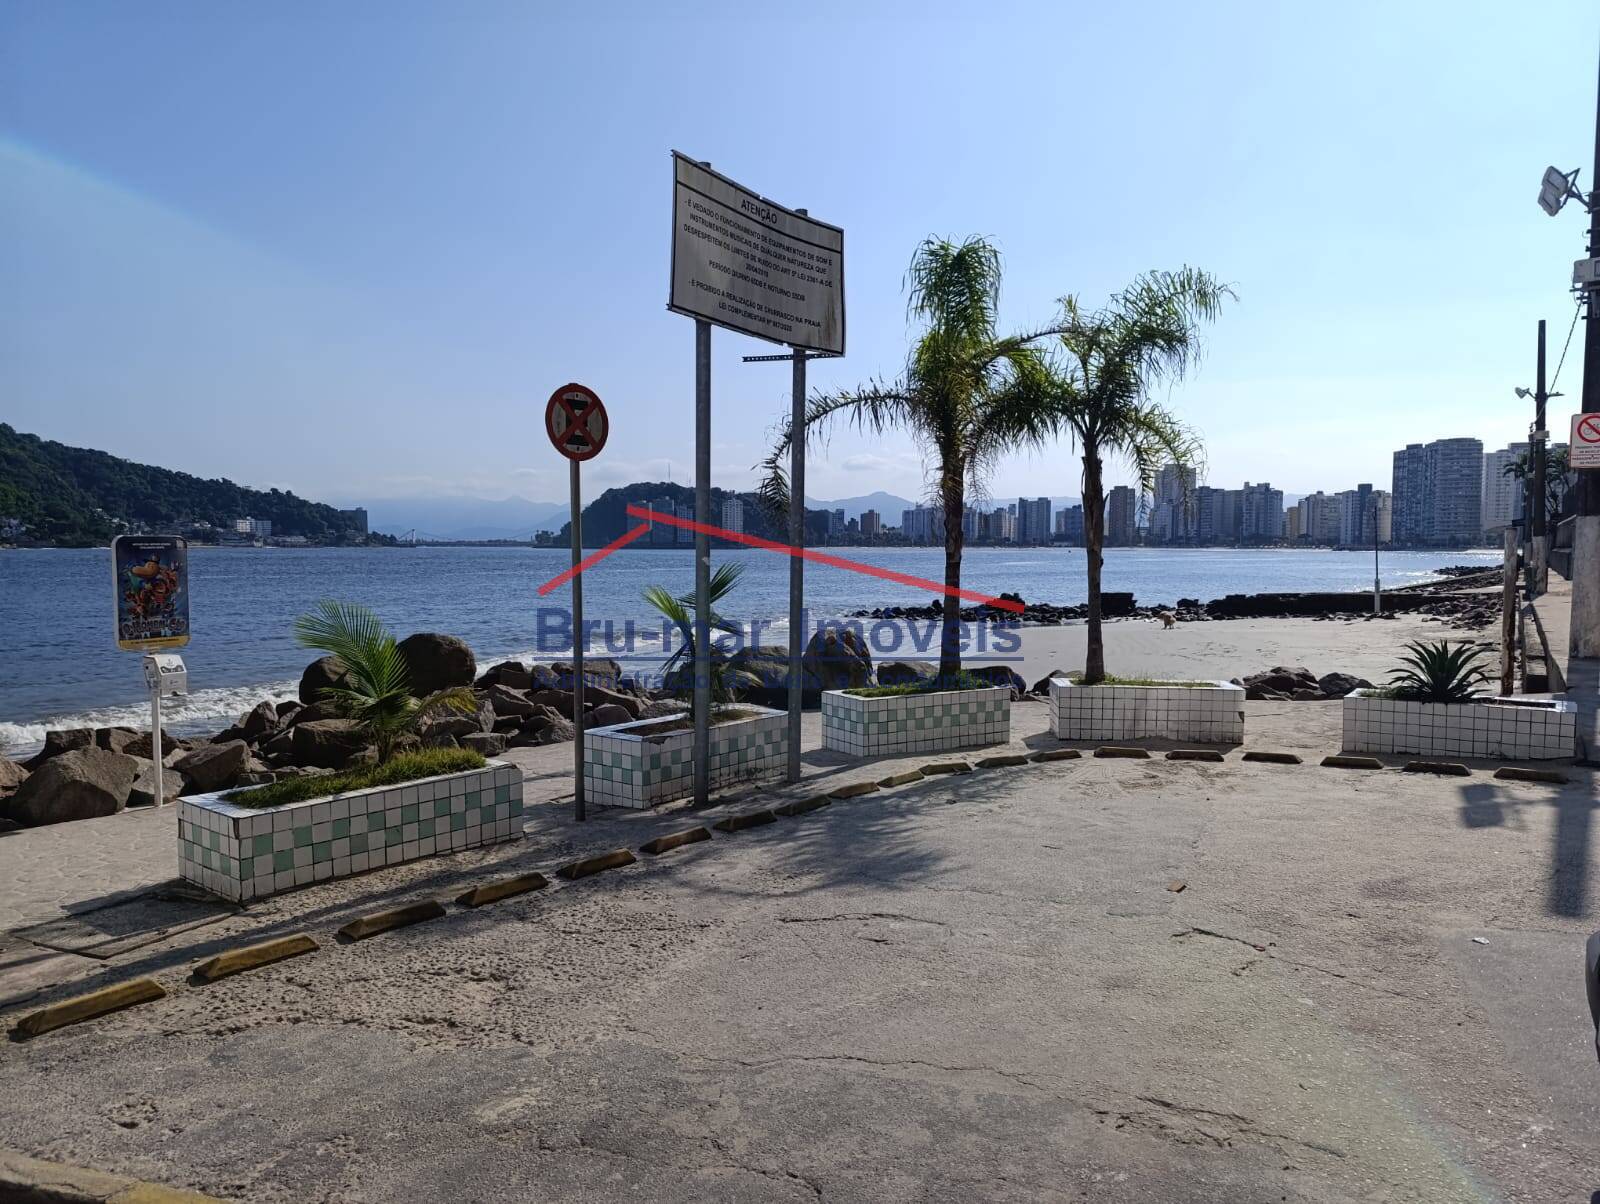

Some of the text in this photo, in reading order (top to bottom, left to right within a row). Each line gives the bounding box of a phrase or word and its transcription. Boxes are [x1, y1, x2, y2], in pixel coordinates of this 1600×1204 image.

[741, 199, 777, 224] ATENÇÃO
[693, 201, 714, 218] VEDADO
[715, 212, 720, 220] O
[720, 215, 760, 240] FUNCIONAMENTO
[761, 234, 768, 243] DE
[769, 238, 806, 258] EQUIPAMENTOS
[807, 252, 815, 260] DE
[683, 223, 723, 247] DESRESPEITEM
[750, 253, 757, 262] DE
[773, 263, 781, 272] DO
[690, 213, 728, 237] INSTRUMENTOS
[730, 231, 752, 248] MUSICAIS
[753, 242, 760, 251] DE
[787, 256, 814, 270] NATUREZA
[815, 265, 827, 275] QUE
[768, 284, 791, 298] NOTURNO
[719, 301, 727, 310] LEI
[757, 303, 764, 312] DE
[764, 305, 795, 322] CHURRASCO
[795, 316, 804, 324] NA
[804, 318, 822, 328] PRAIA
